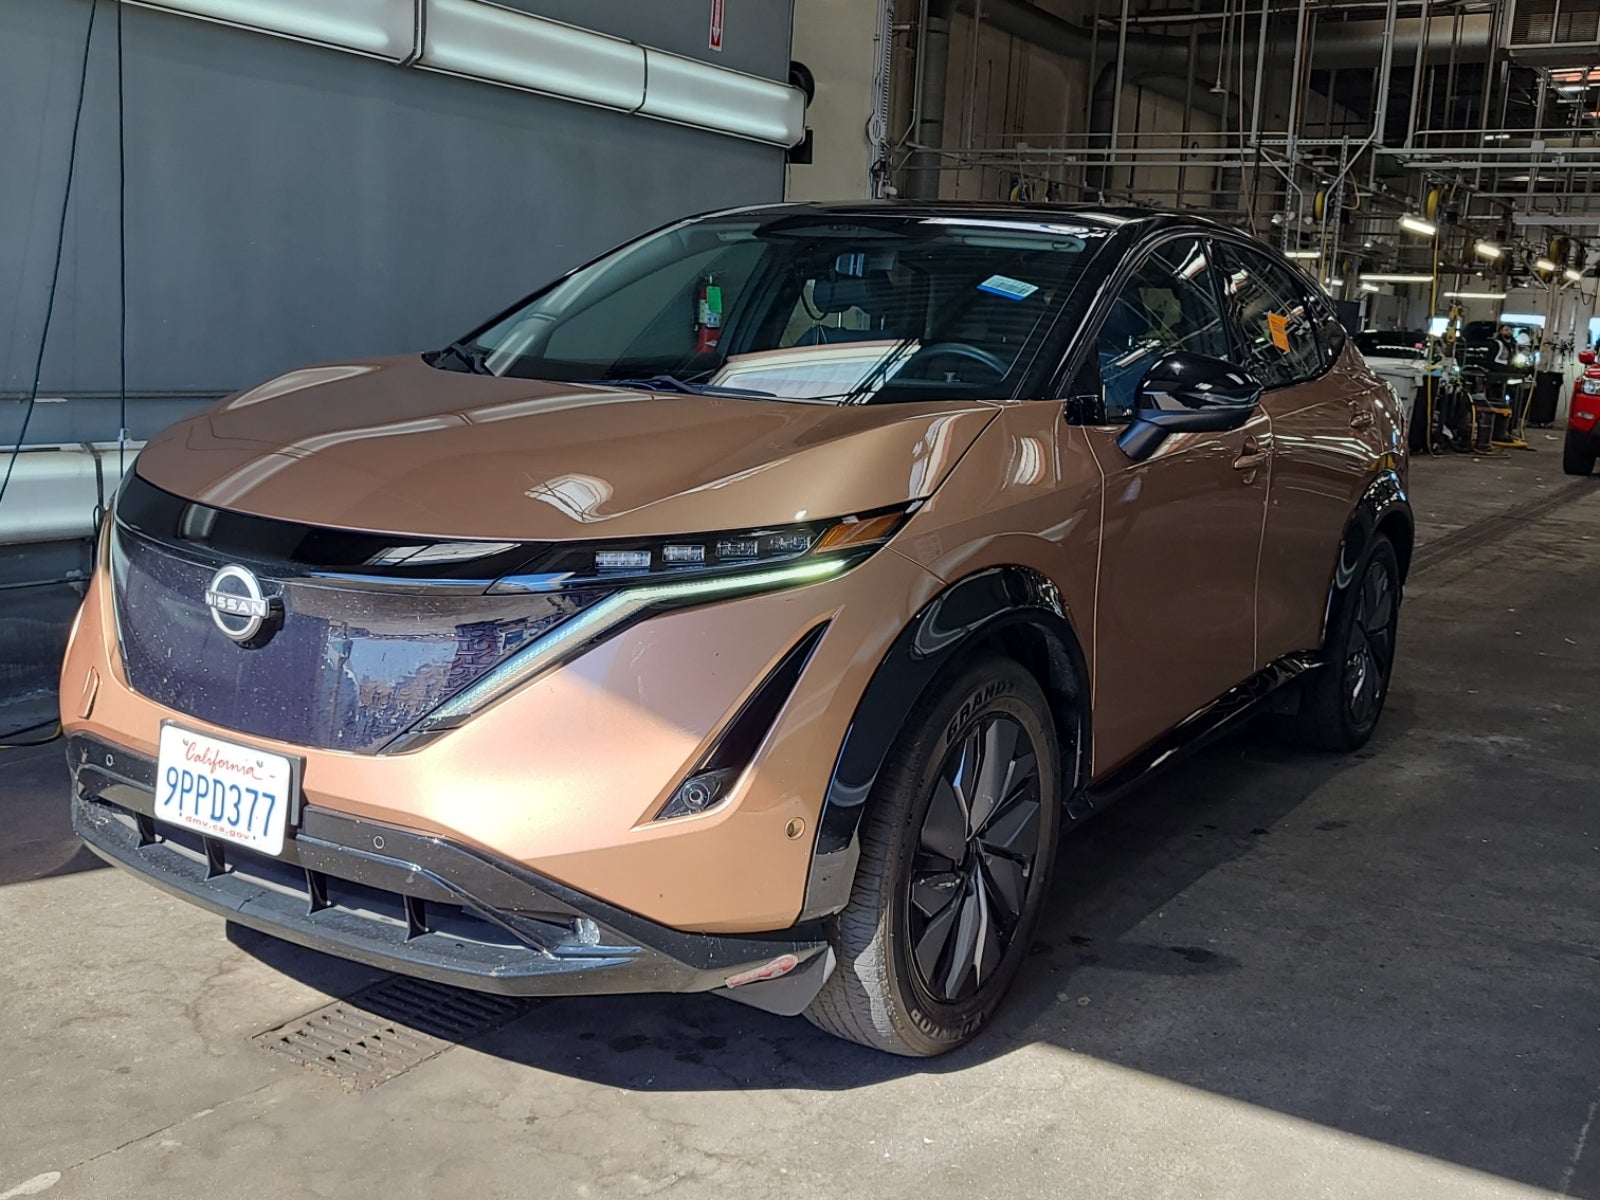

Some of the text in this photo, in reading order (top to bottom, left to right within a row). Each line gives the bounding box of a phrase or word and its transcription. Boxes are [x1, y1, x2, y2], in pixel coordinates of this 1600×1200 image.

[206, 590, 266, 617] NISSAN
[185, 741, 263, 781] California
[163, 766, 276, 837] 9PPD377
[185, 815, 250, 839] dmv.ca.gov
